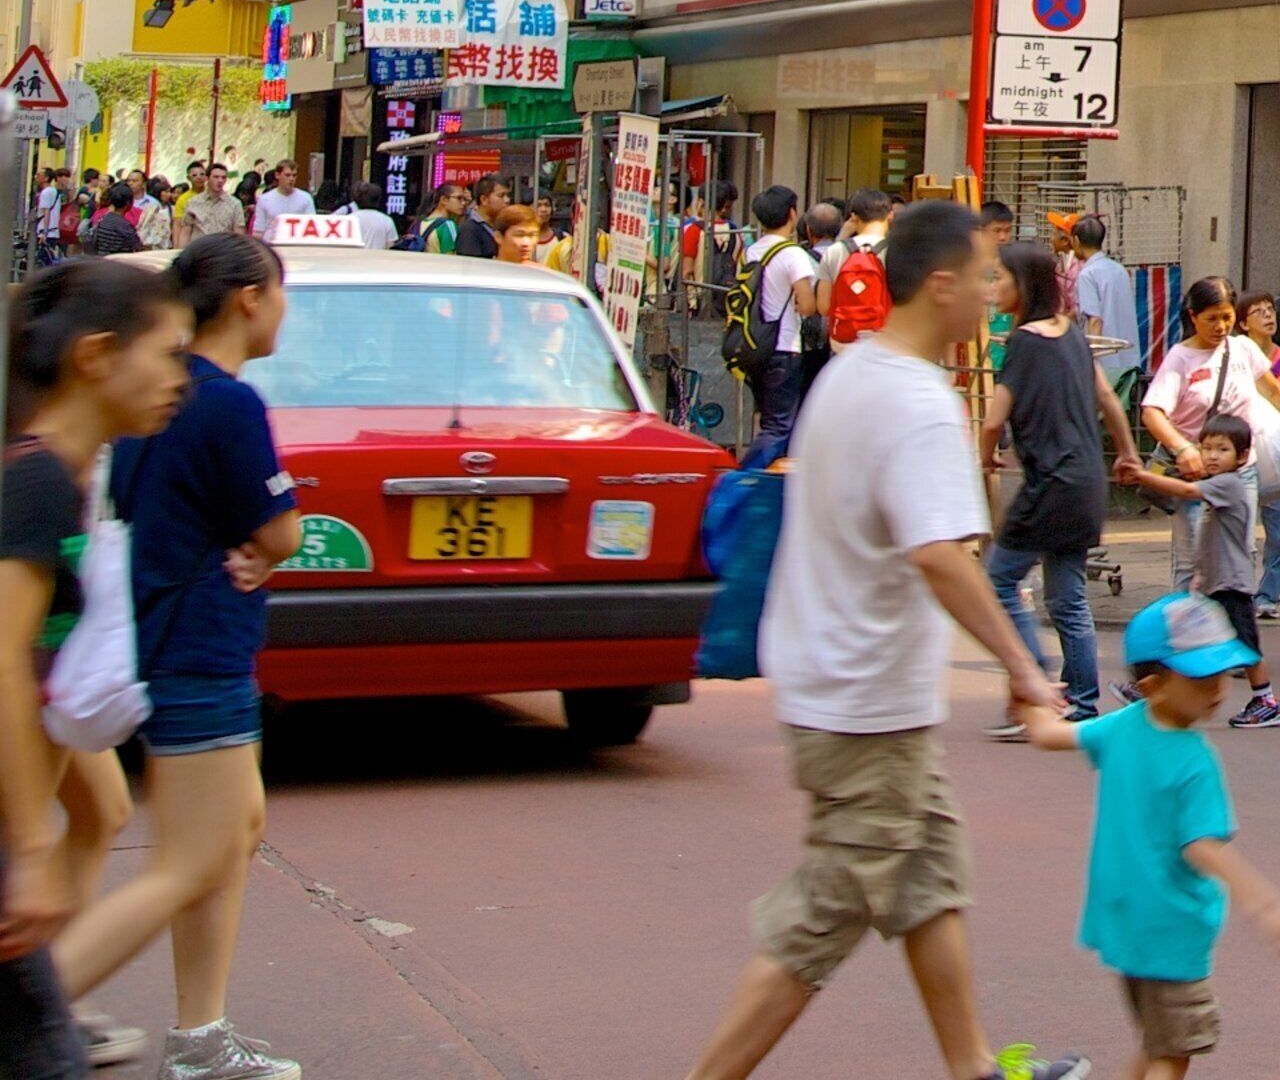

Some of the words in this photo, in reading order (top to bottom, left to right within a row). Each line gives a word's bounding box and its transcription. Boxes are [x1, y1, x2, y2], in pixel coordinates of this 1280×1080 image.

[1023, 42, 1045, 51] am
[1015, 54, 1051, 70] 上午
[1073, 45, 1092, 72] 7
[1000, 85, 1064, 99] midnight
[1013, 101, 1049, 118] 午夜
[1073, 92, 1108, 121] 12
[286, 219, 354, 238] TAXI
[446, 495, 497, 527] KE
[302, 534, 329, 556] 5
[436, 527, 506, 557] 361
